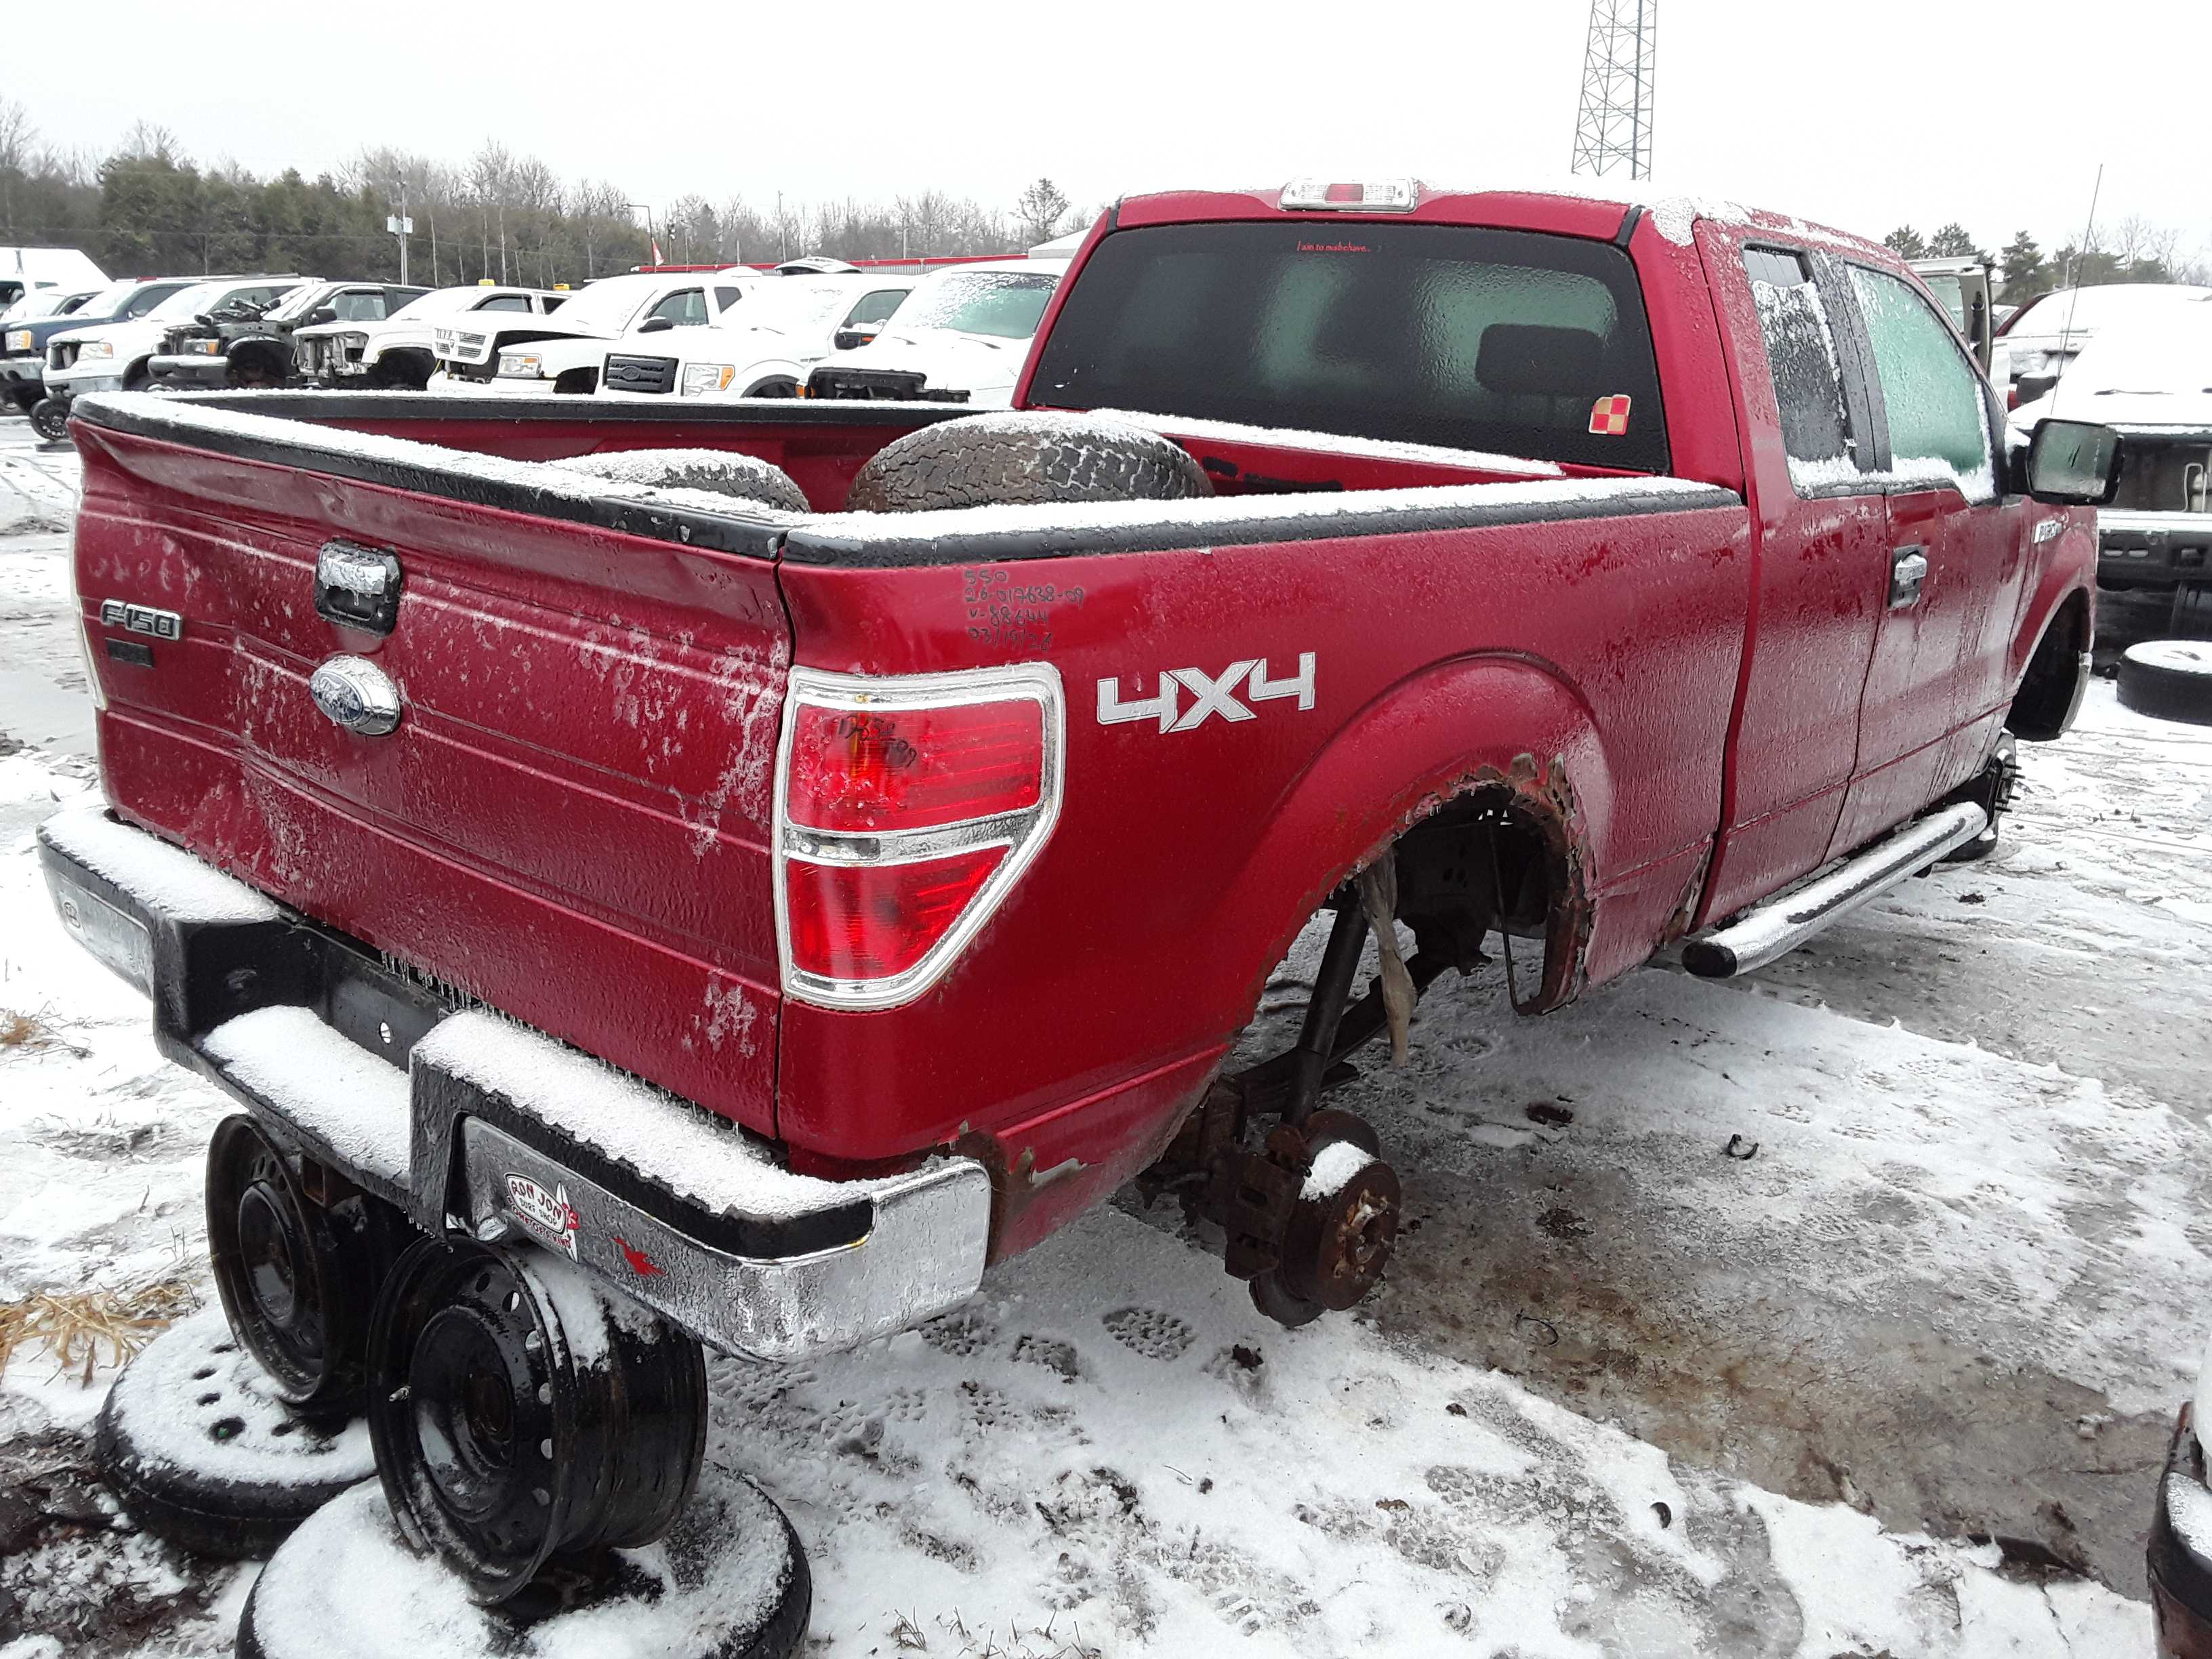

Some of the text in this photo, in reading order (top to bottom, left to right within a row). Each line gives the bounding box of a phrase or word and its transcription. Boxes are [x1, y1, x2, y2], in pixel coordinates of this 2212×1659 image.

[510, 1180, 562, 1221] RON JON
[518, 1197, 558, 1226] SURF SHOP
